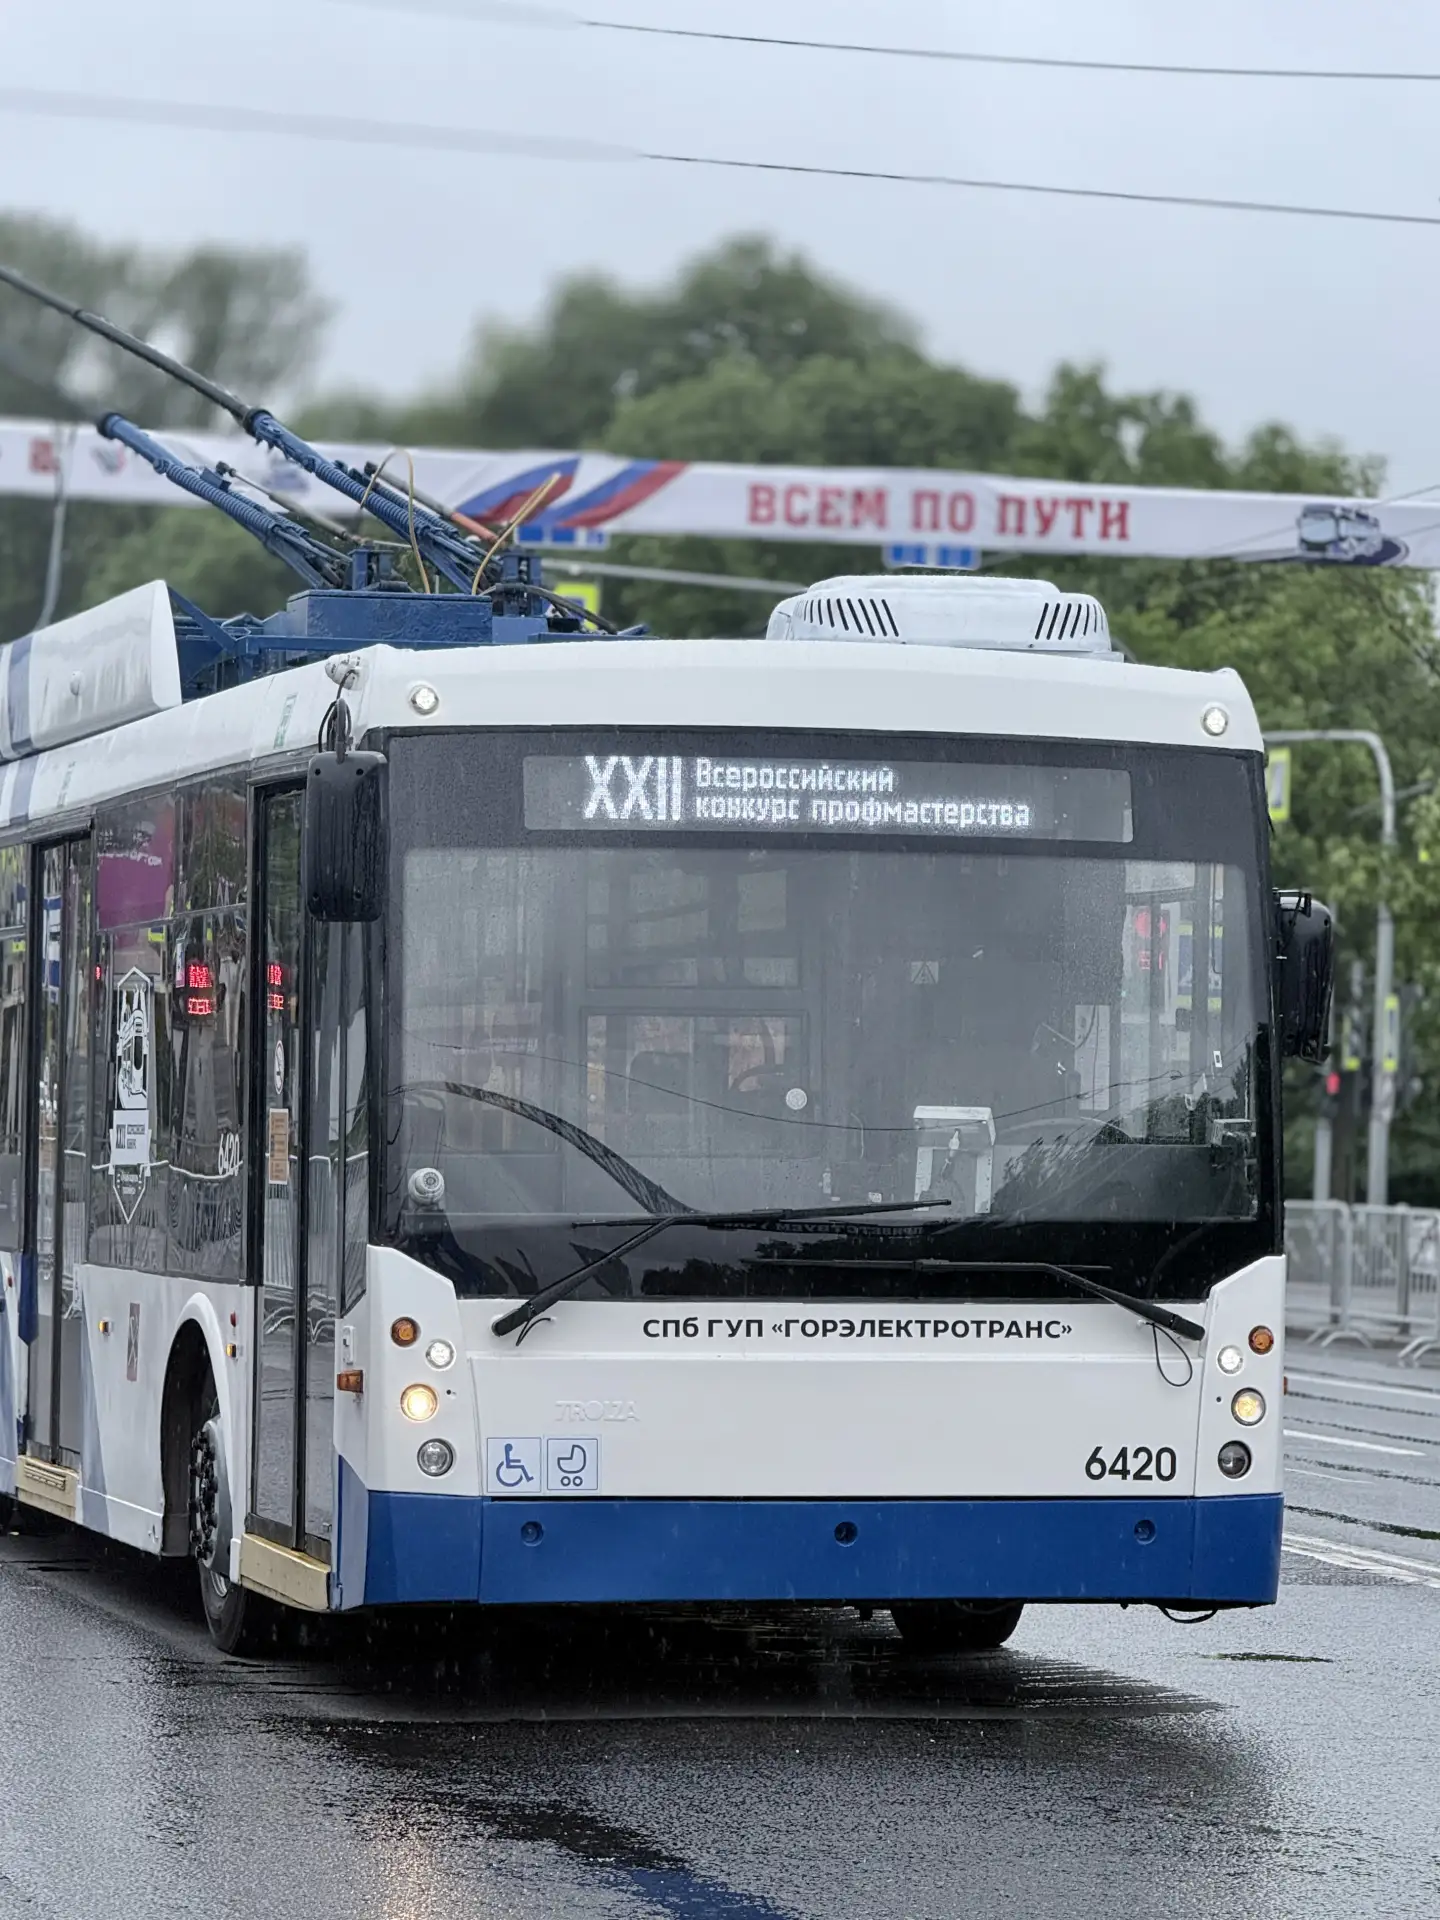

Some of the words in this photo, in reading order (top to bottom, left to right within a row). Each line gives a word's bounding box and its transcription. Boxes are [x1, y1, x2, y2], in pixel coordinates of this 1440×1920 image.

[747, 483, 888, 528] ВСЕМ
[912, 488, 975, 532] ПО
[996, 494, 1130, 541] ПУТИ
[583, 755, 682, 821] XXII
[696, 757, 893, 792] Всероссийский
[696, 794, 799, 821] конкурс
[811, 797, 1030, 829] профмастерства
[217, 1132, 240, 1177] 6420
[642, 1317, 699, 1338] СПб
[707, 1319, 764, 1338] ГУП
[771, 1319, 1073, 1339] «ГОРЭЛЕКТРОТРАНС»
[554, 1399, 641, 1423] TROLZA
[1085, 1446, 1177, 1482] 6420
